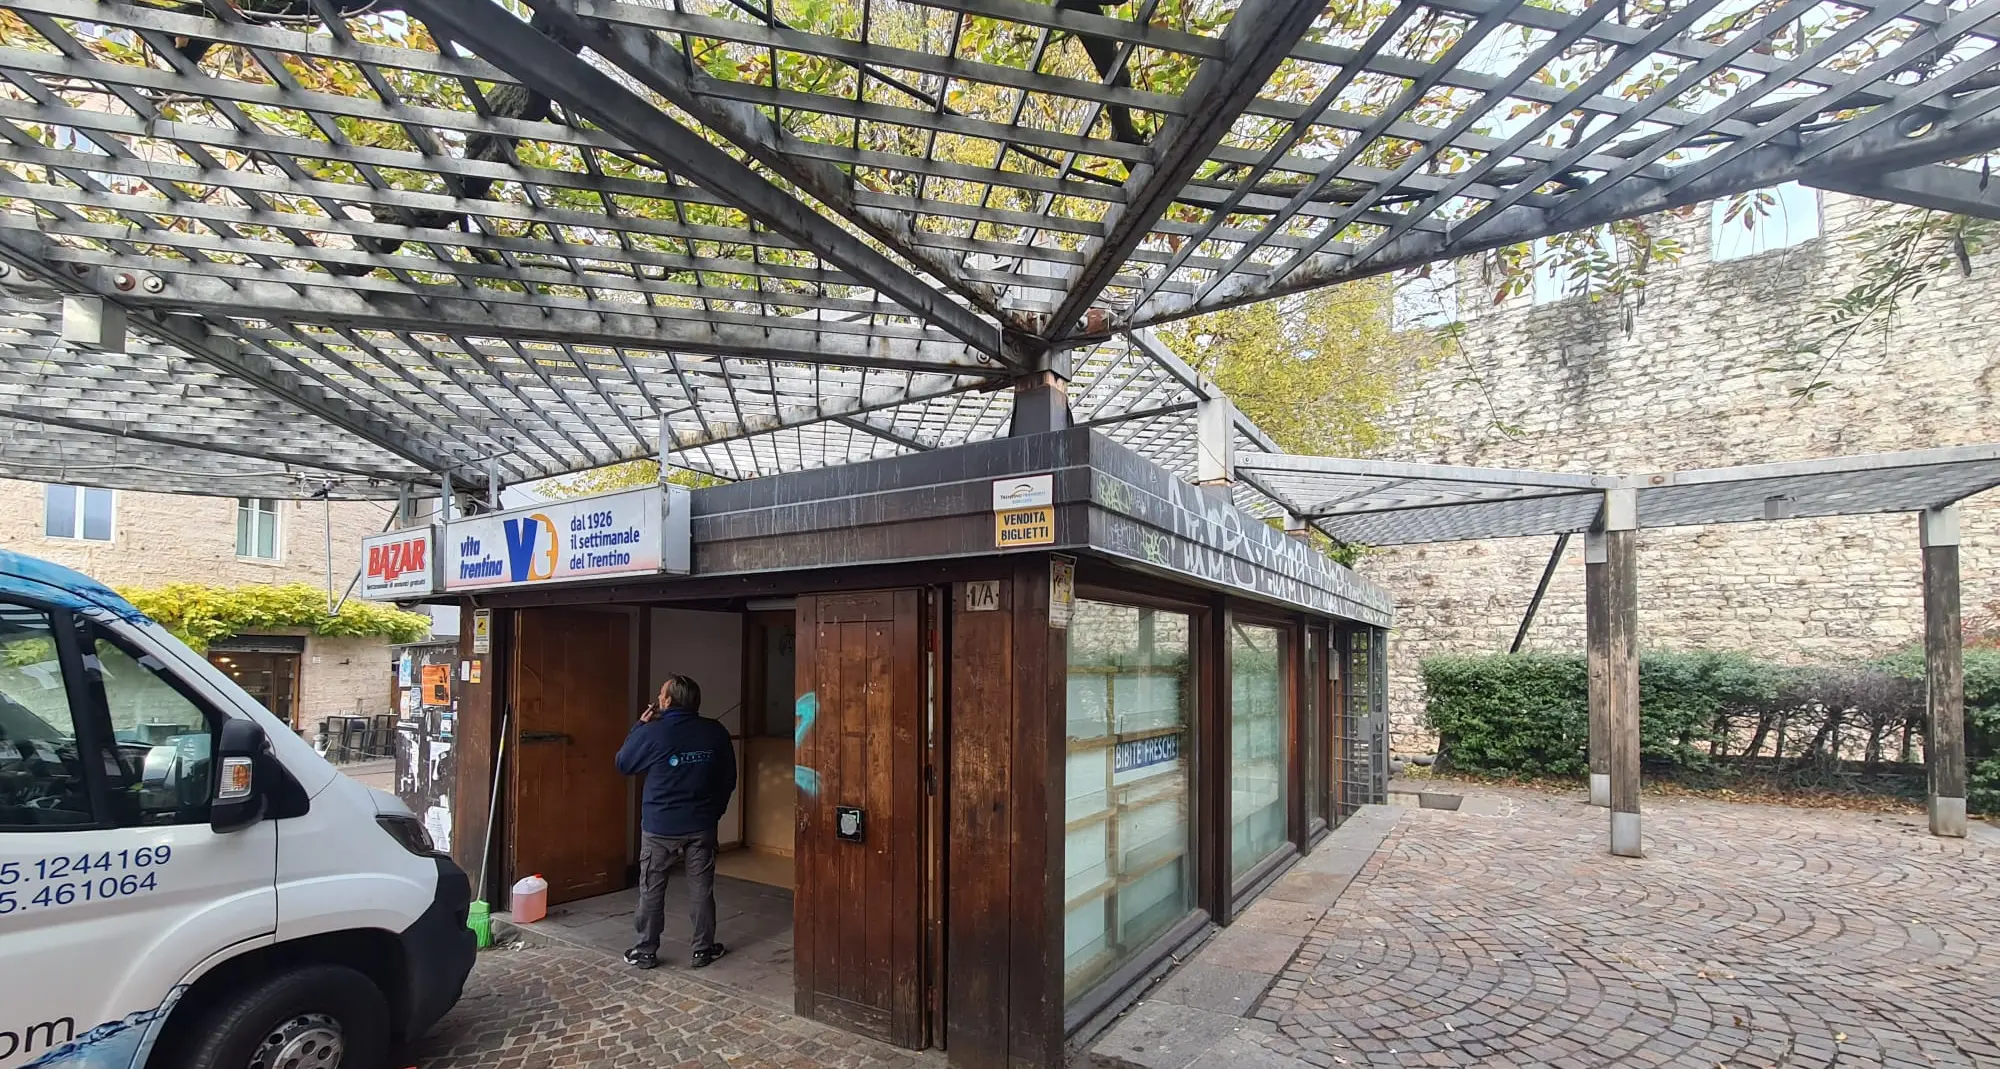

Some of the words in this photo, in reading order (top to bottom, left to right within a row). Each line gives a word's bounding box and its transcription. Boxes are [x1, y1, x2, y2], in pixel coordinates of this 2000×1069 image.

[570, 515, 585, 531] dal
[588, 510, 613, 529] 1926
[1003, 511, 1046, 526] VENDITA
[570, 535, 577, 551] il
[579, 527, 640, 548] settimanale
[1001, 526, 1049, 541] BIGLIETTI
[460, 535, 481, 558] vita
[367, 538, 426, 581] BAZAR
[459, 556, 503, 580] trentina
[569, 555, 585, 571] del
[587, 549, 631, 568] Trentino
[1115, 742, 1141, 769] BIBITE
[1144, 735, 1177, 763] FRESCHE
[0, 845, 172, 885] 5.1244169
[0, 871, 158, 914] 5.461064
